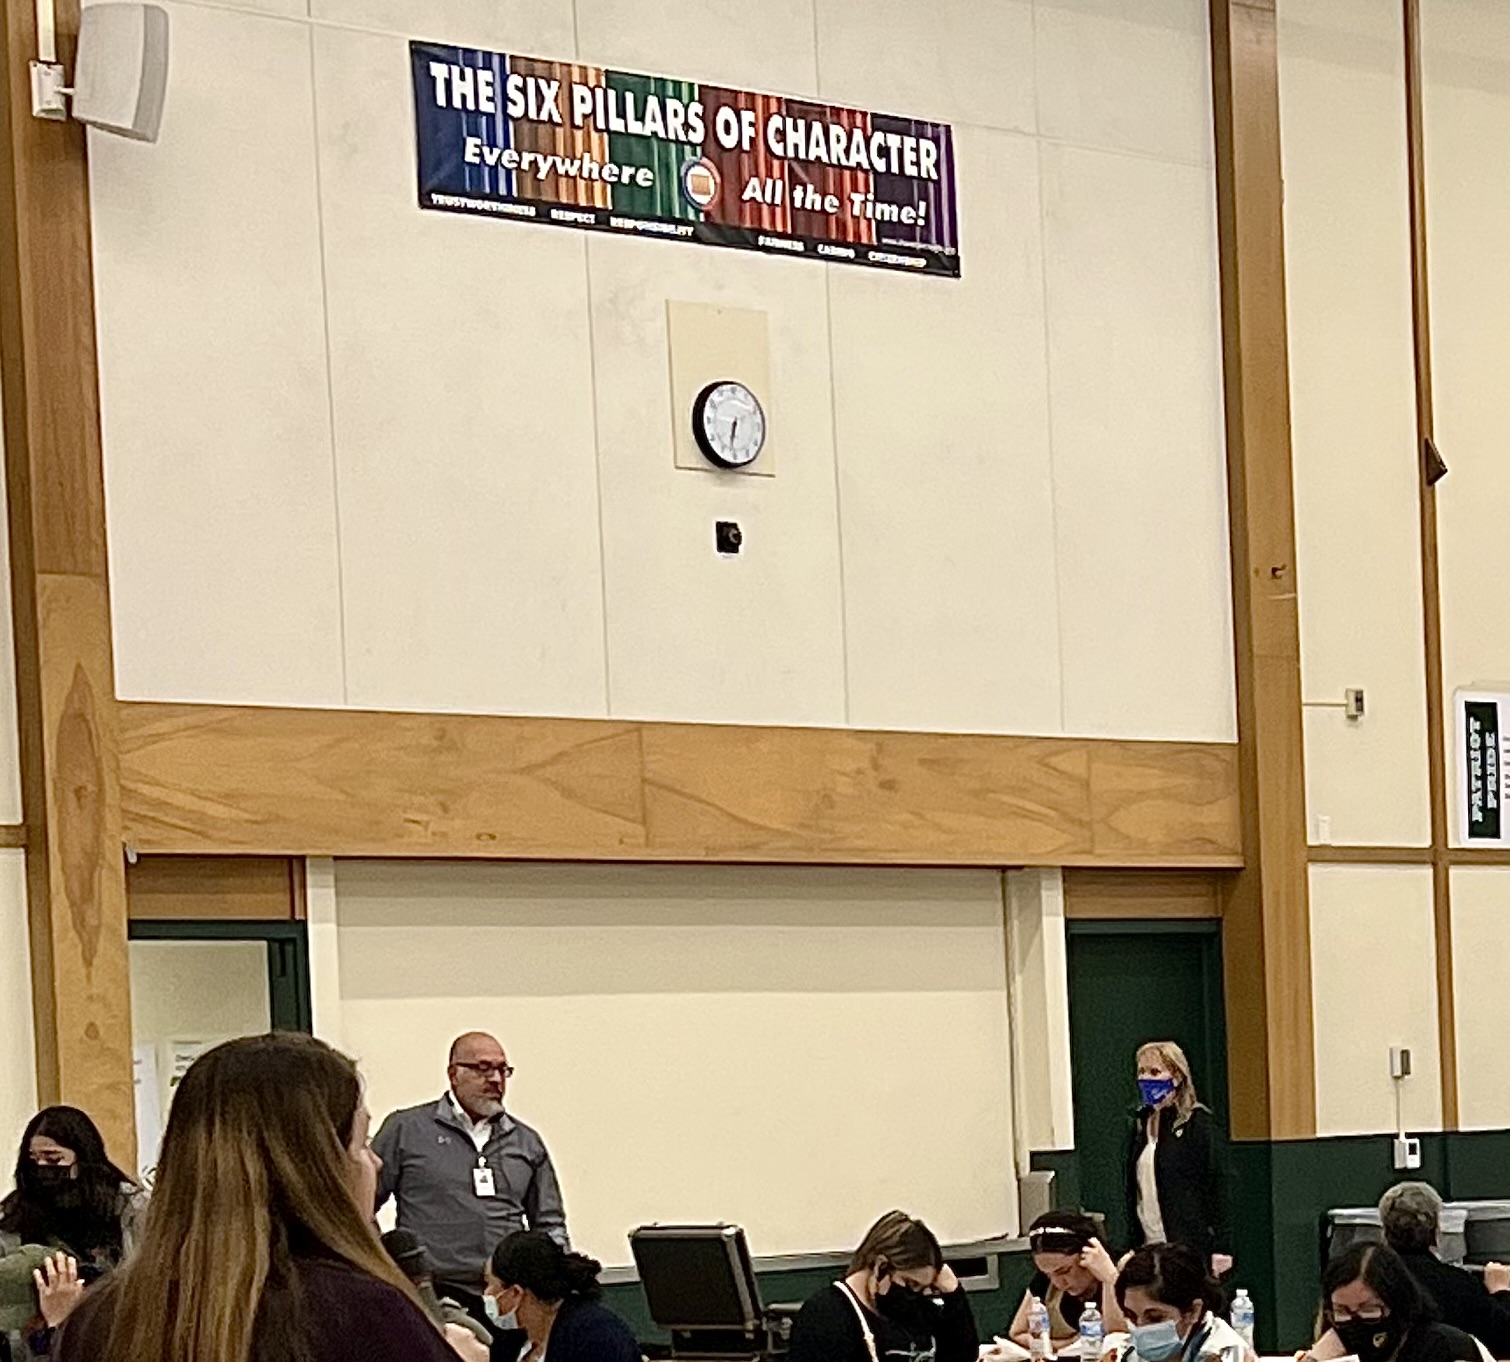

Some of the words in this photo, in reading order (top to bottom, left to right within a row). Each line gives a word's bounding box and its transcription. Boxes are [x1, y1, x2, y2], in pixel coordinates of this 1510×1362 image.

[429, 60, 496, 114] THE
[506, 73, 563, 125] SIX
[572, 81, 706, 145] PILLARS
[715, 105, 757, 151] OF
[766, 113, 939, 181] CHARACTER
[463, 136, 654, 187] Everywhere
[741, 176, 784, 205] All
[792, 184, 840, 213] the
[850, 192, 928, 226] Time!
[1469, 716, 1483, 822] PATRIOT
[1485, 731, 1497, 809] PRIDE
